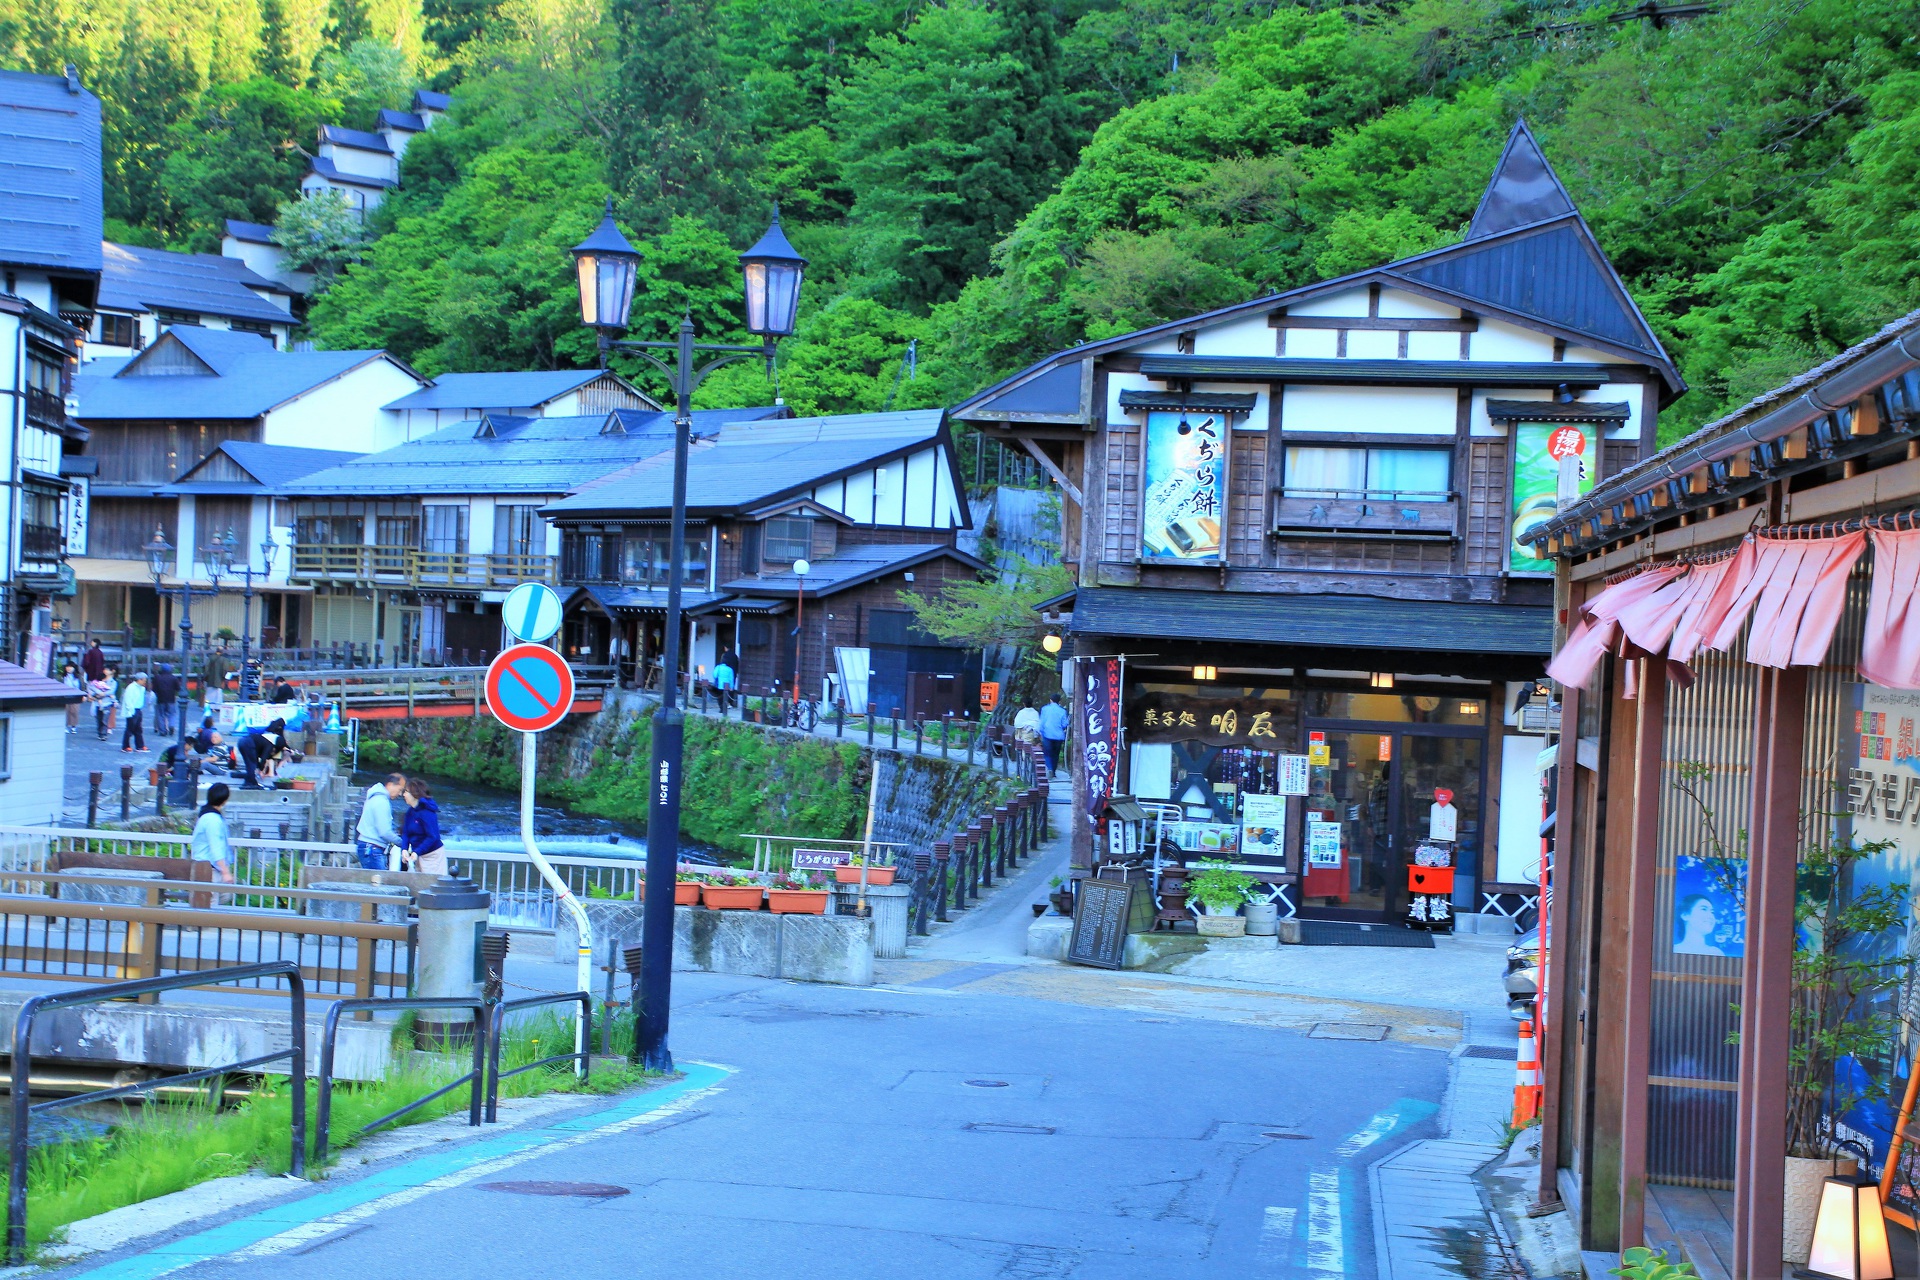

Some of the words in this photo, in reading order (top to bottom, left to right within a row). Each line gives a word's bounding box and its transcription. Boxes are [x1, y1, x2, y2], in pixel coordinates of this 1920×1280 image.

[1191, 416, 1219, 518] くぢら餅
[1143, 708, 1197, 727] 菓子処
